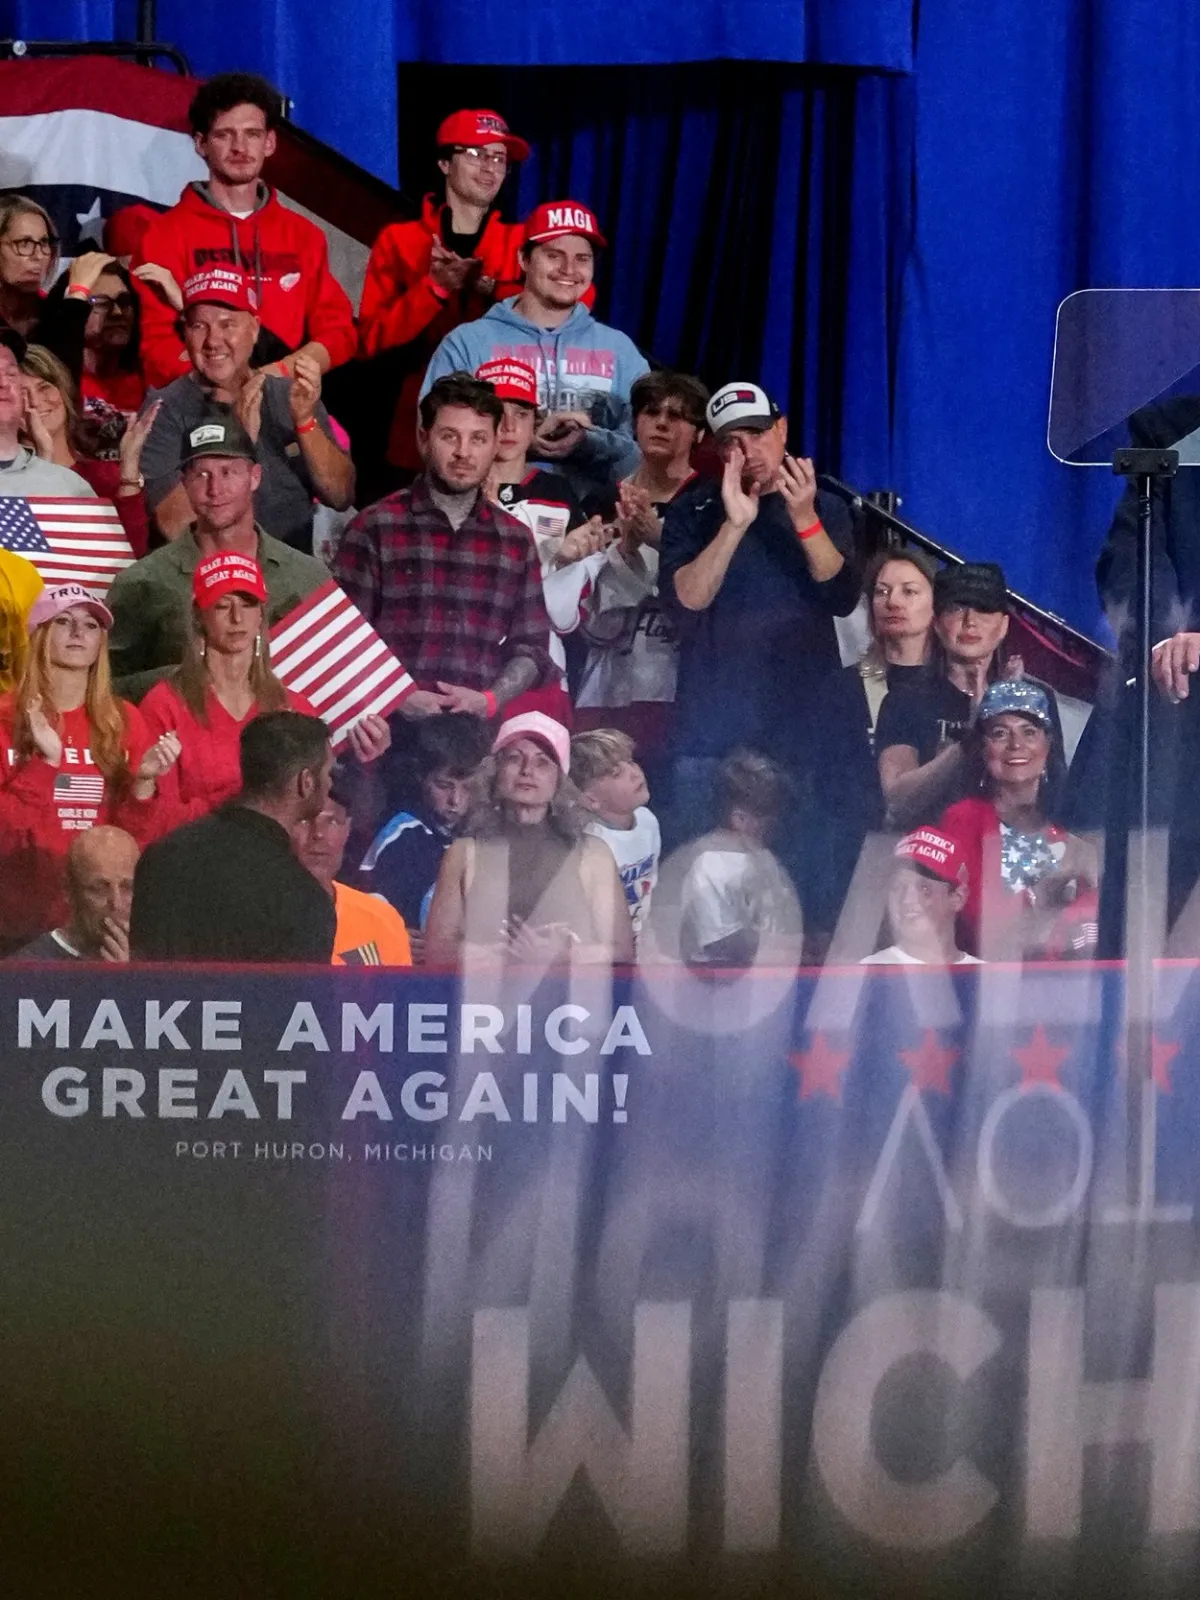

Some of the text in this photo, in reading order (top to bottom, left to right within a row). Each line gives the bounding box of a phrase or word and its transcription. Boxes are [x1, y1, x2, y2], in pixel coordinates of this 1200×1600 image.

[210, 281, 239, 293] AGAIN
[503, 364, 534, 385] AMERICA
[916, 845, 948, 864] AGAIN
[17, 999, 653, 1056] MAKE AMERICA
[41, 1066, 629, 1123] GREAT AGAIN!
[175, 1142, 493, 1163] PORT HURON, MICHIGAN
